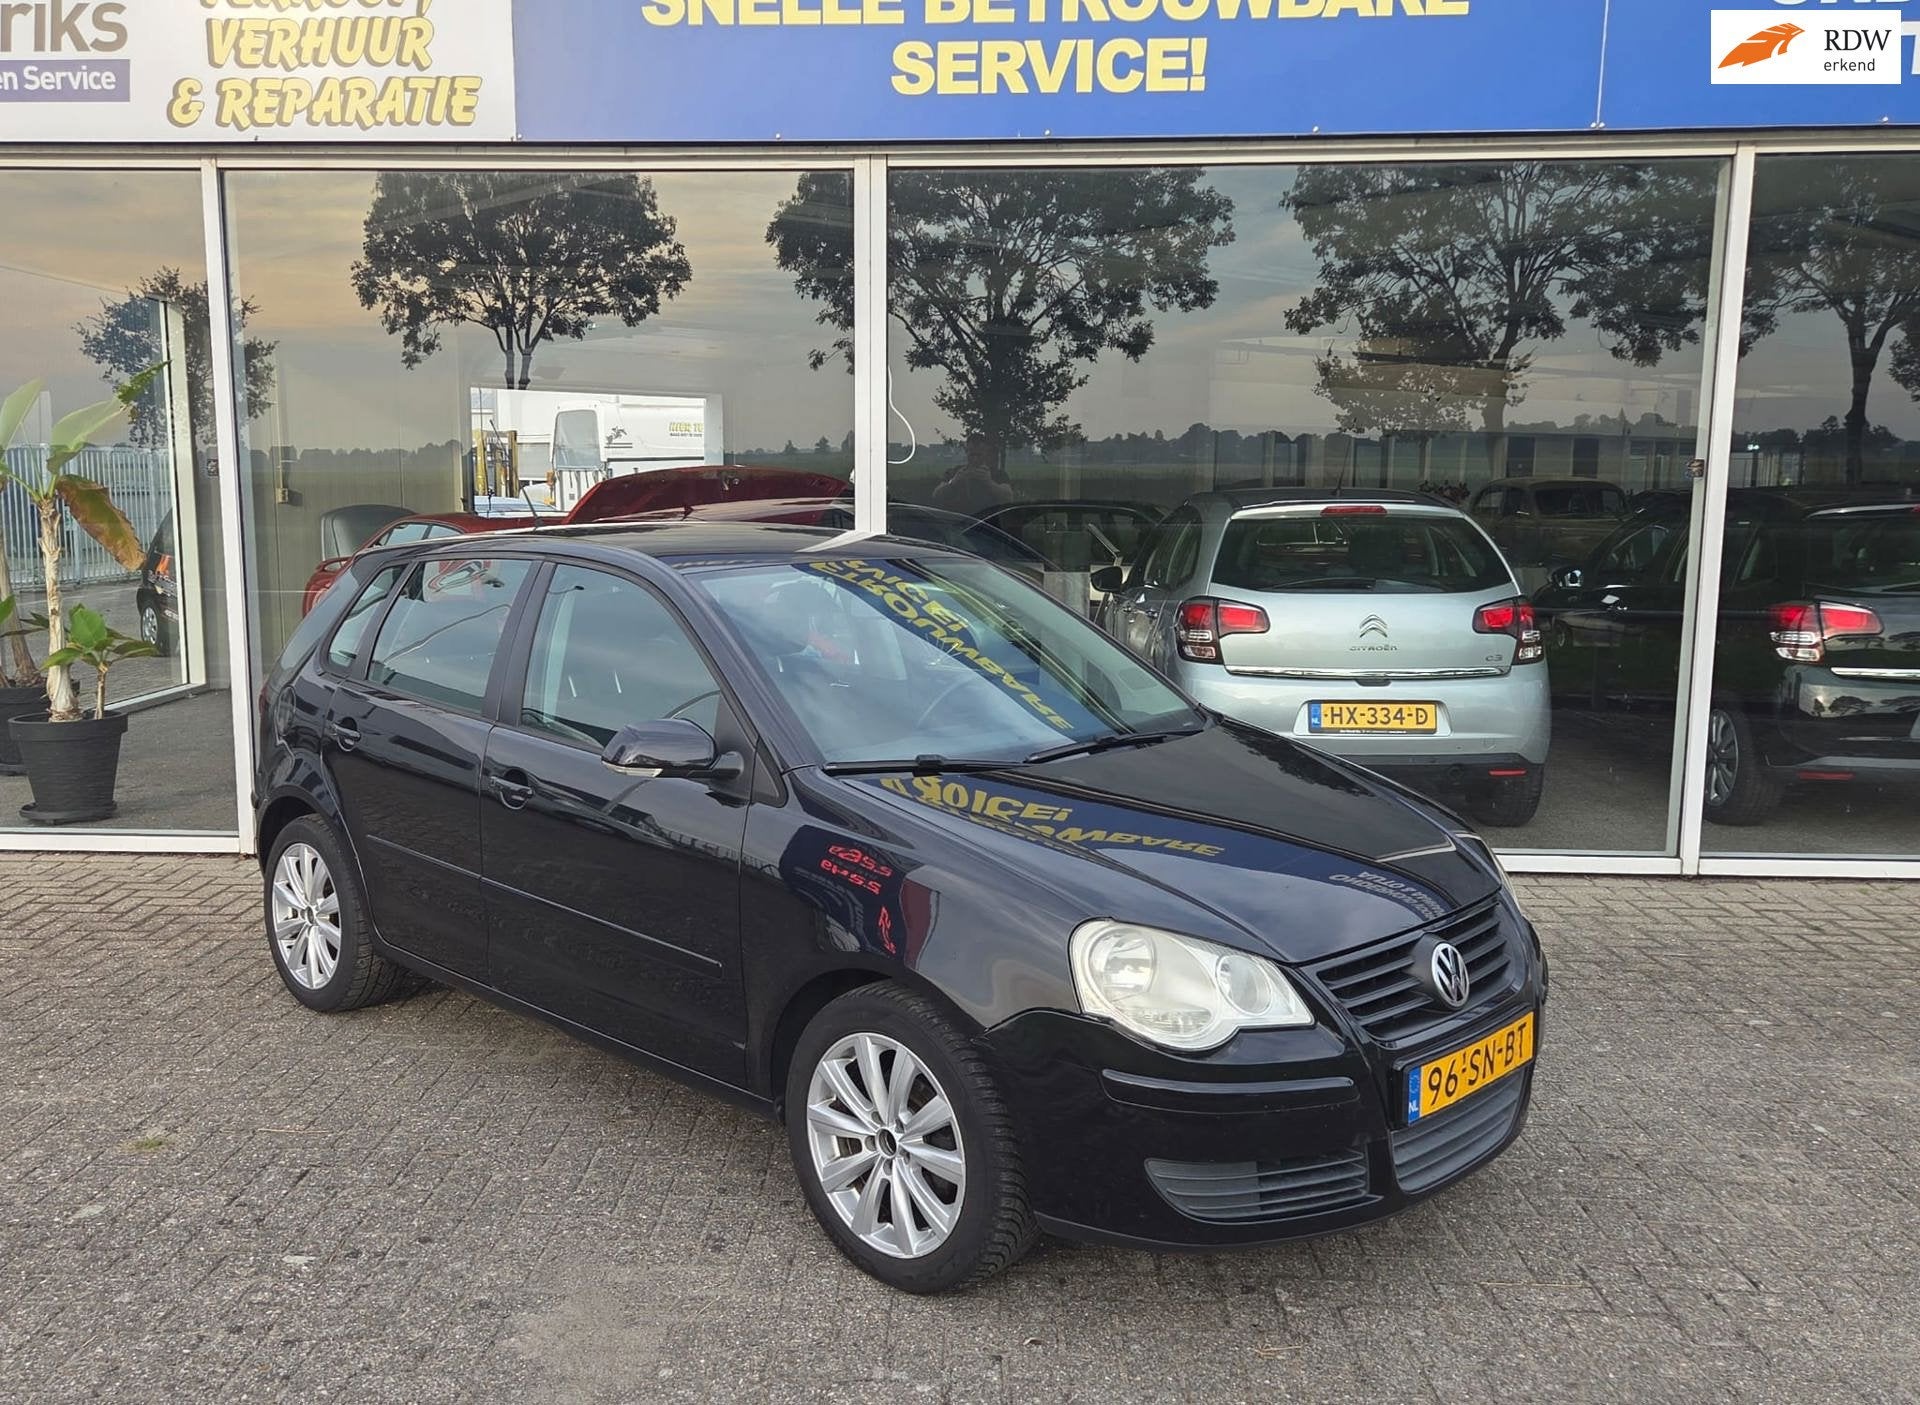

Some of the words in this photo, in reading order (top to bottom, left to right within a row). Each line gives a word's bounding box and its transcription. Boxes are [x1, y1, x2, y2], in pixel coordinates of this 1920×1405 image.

[206, 17, 434, 71] VERHUUR
[891, 38, 1207, 95] SERVICE!
[23, 65, 116, 90] Service
[167, 77, 204, 128] &
[217, 75, 482, 131] REPARATIE
[1330, 706, 1428, 725] HX-334-D
[1428, 1022, 1527, 1106] 96-SN-BT
[1408, 1101, 1419, 1113] NL
